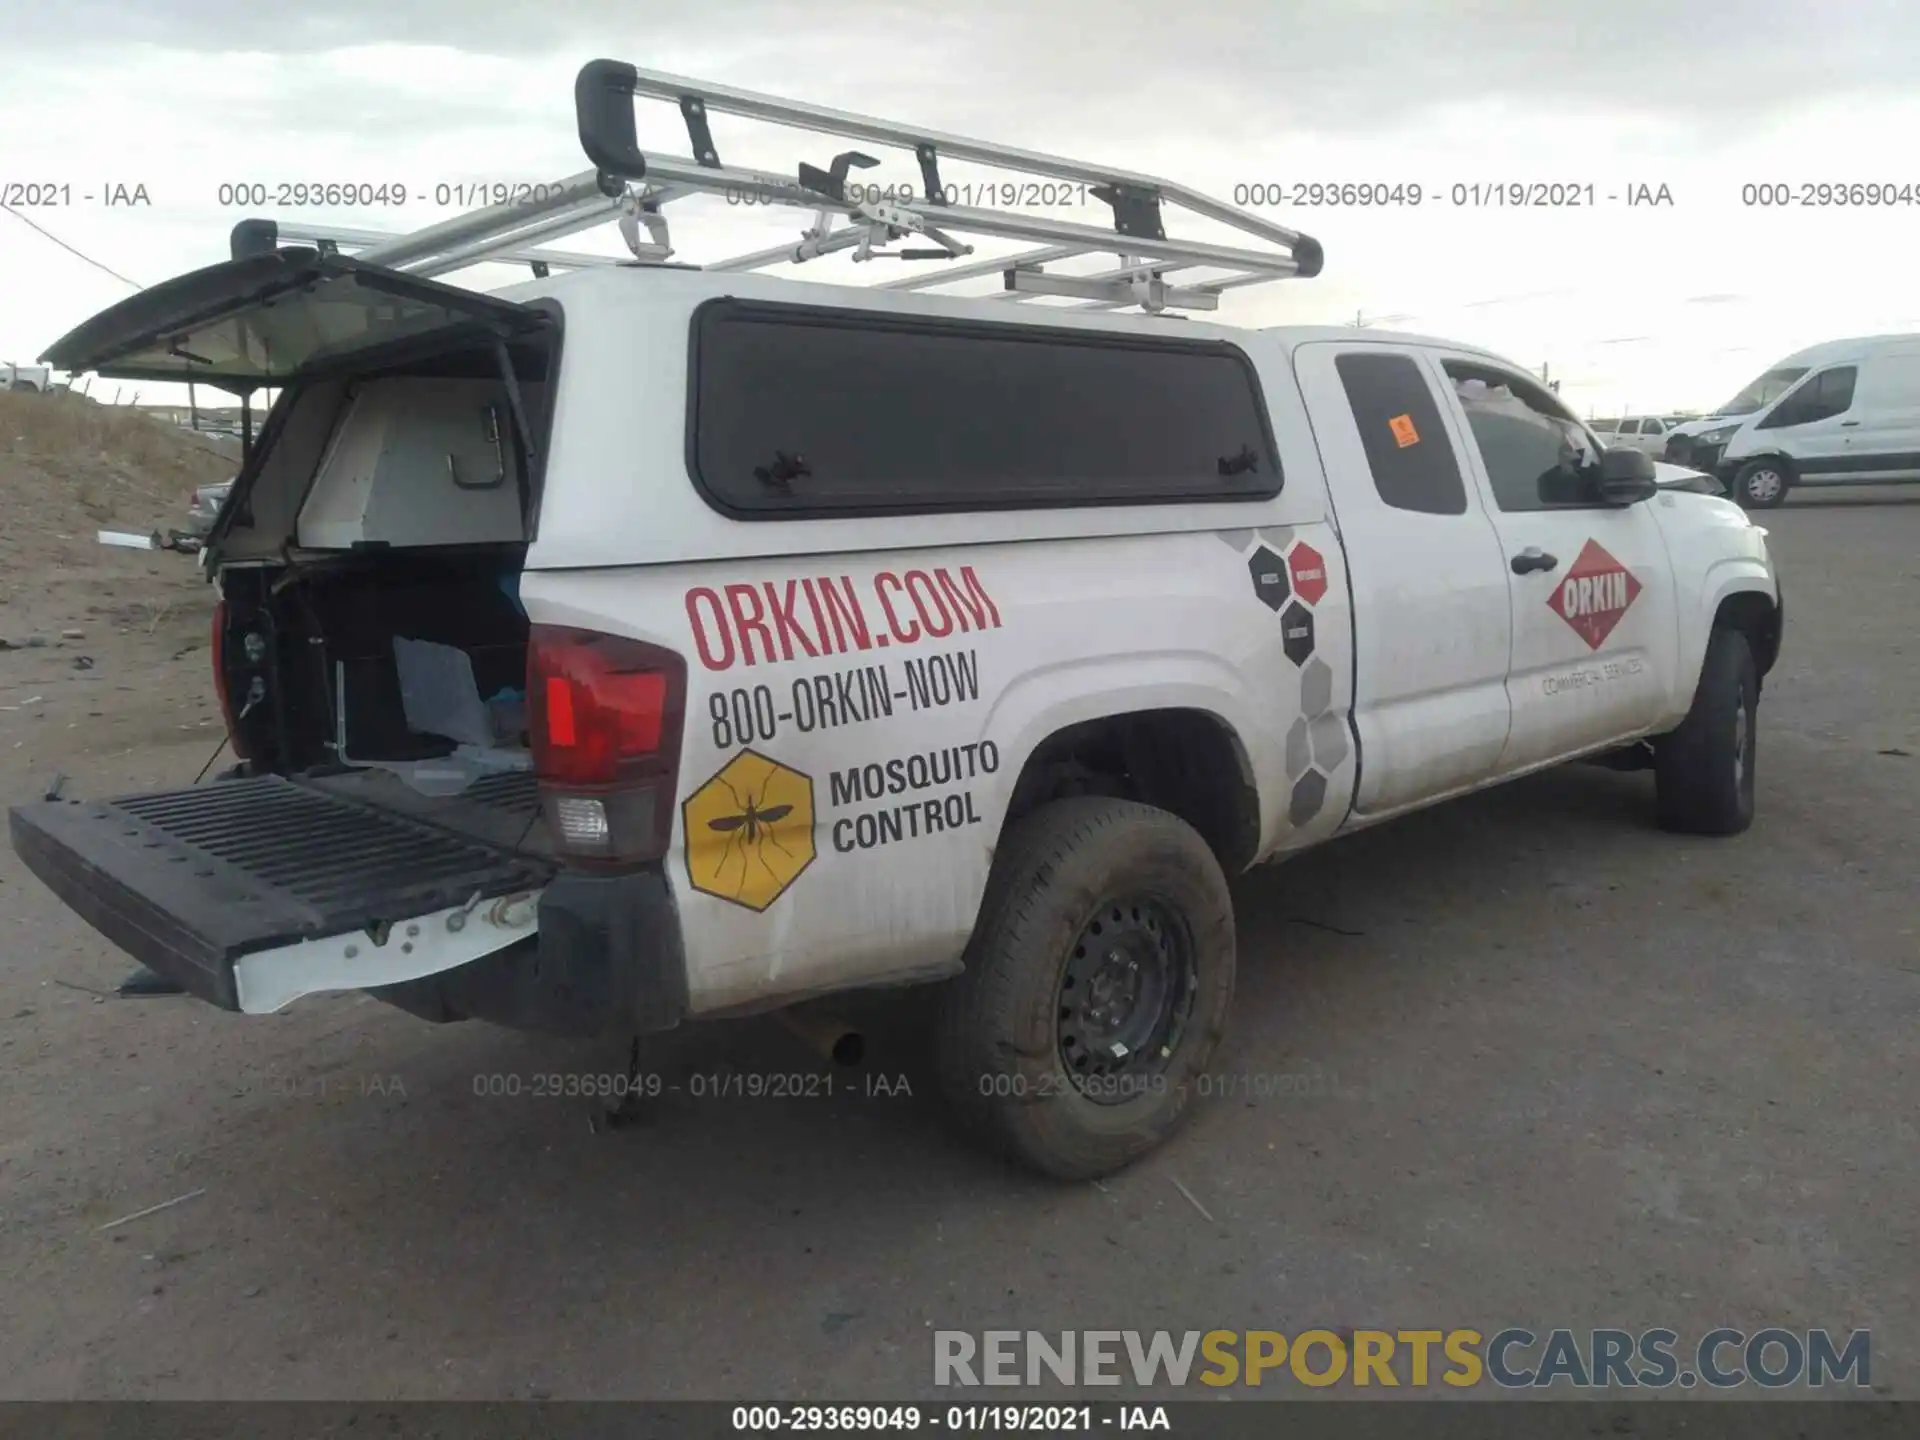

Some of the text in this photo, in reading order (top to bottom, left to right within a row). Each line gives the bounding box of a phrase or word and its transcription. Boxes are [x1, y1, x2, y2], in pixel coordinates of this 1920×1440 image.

[685, 566, 1002, 671] ORKIN.COM
[1563, 571, 1627, 619] ORKIN
[709, 649, 980, 749] 800-ORKIN-NOW
[830, 740, 999, 807] MOSQUITO
[832, 792, 982, 853] CONTROL
